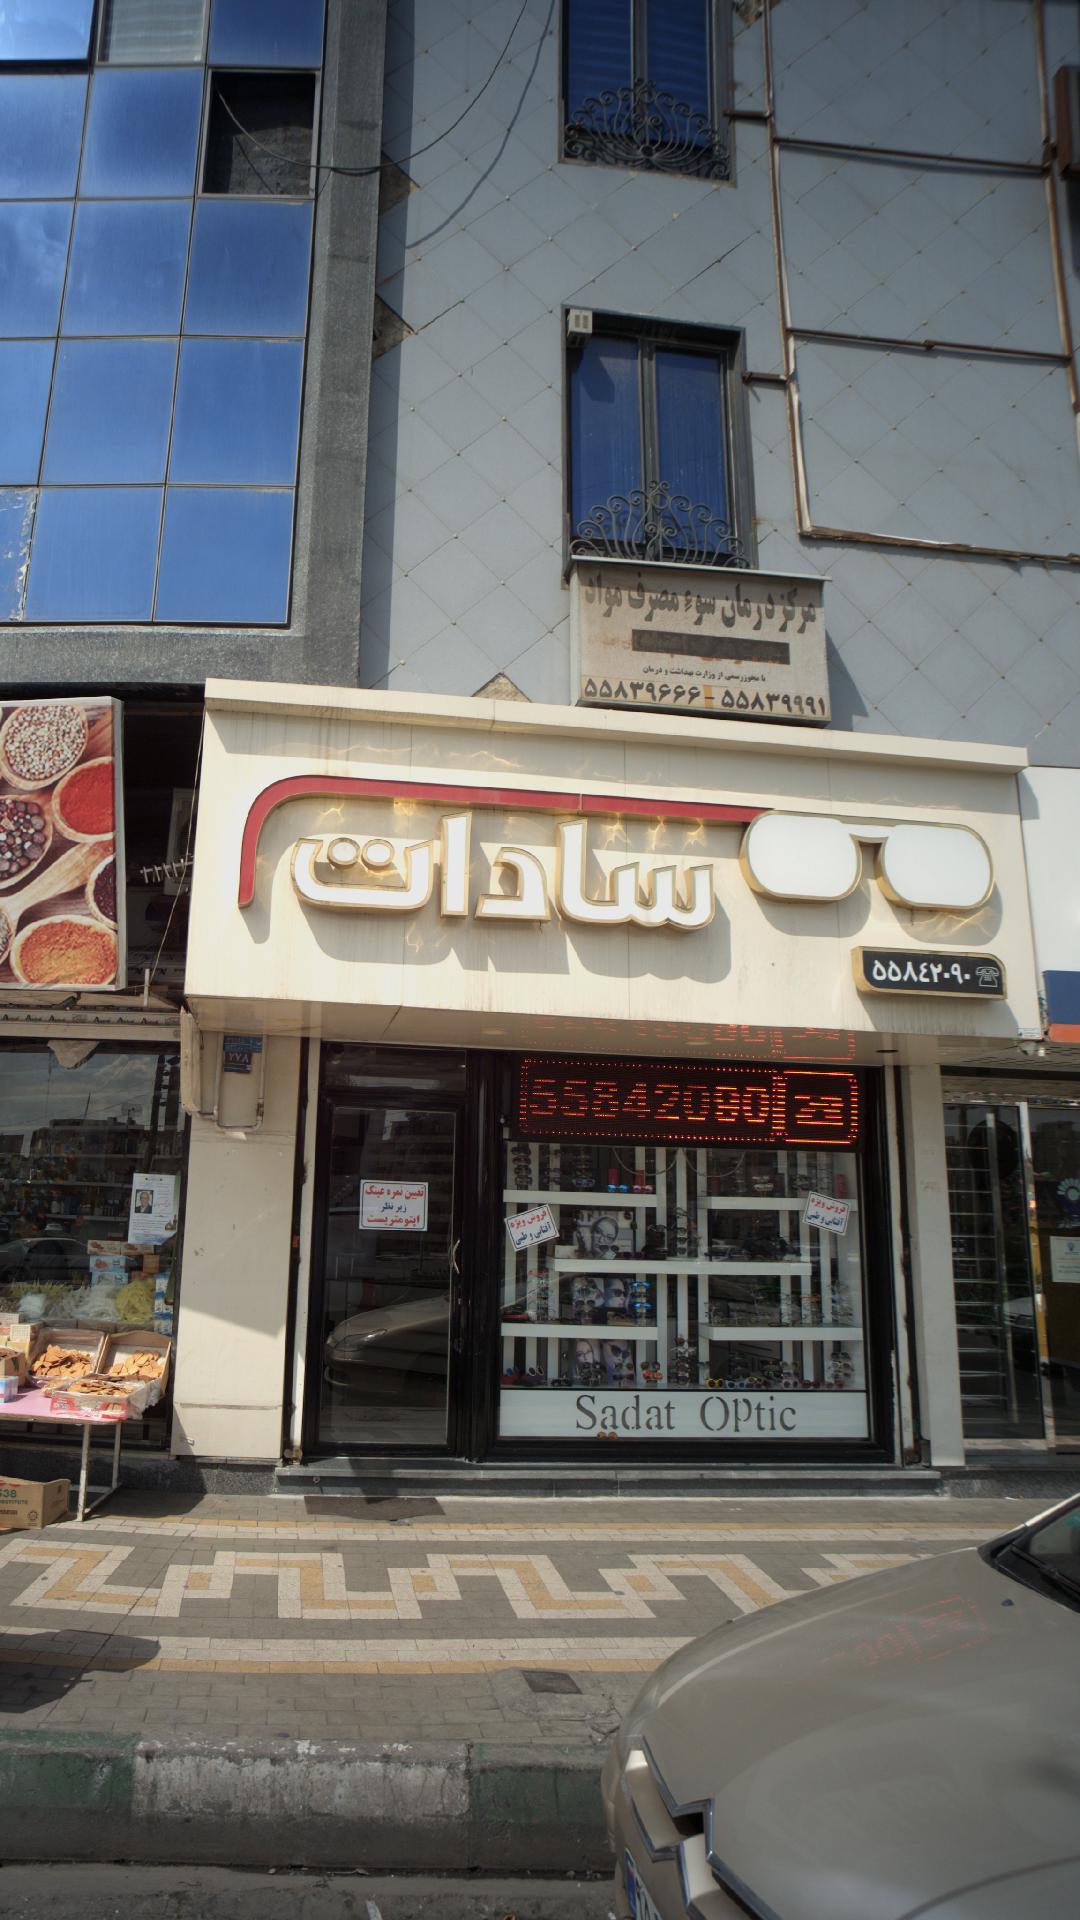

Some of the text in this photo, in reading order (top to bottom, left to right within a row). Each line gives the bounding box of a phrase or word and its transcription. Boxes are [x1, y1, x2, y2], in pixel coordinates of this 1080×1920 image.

[585, 573, 623, 618] مواد
[627, 571, 680, 622] مصرف
[722, 583, 775, 629] درمان
[779, 586, 817, 634] مرکز
[642, 665, 662, 675] درمان
[669, 666, 694, 677] بهداشت
[695, 670, 716, 680] وزارت
[584, 677, 701, 704] ۵۵۸۳۹۶۶۶
[721, 690, 826, 716] ۵۵۸۳۹۹۹۱
[290, 811, 717, 932] سادات
[365, 1184, 424, 1200] تعیین نمره عینک
[381, 1202, 407, 1213] زیر نظر
[527, 1210, 547, 1225] فروش
[825, 1202, 846, 1215] فروش
[576, 1395, 676, 1431] Sadat
